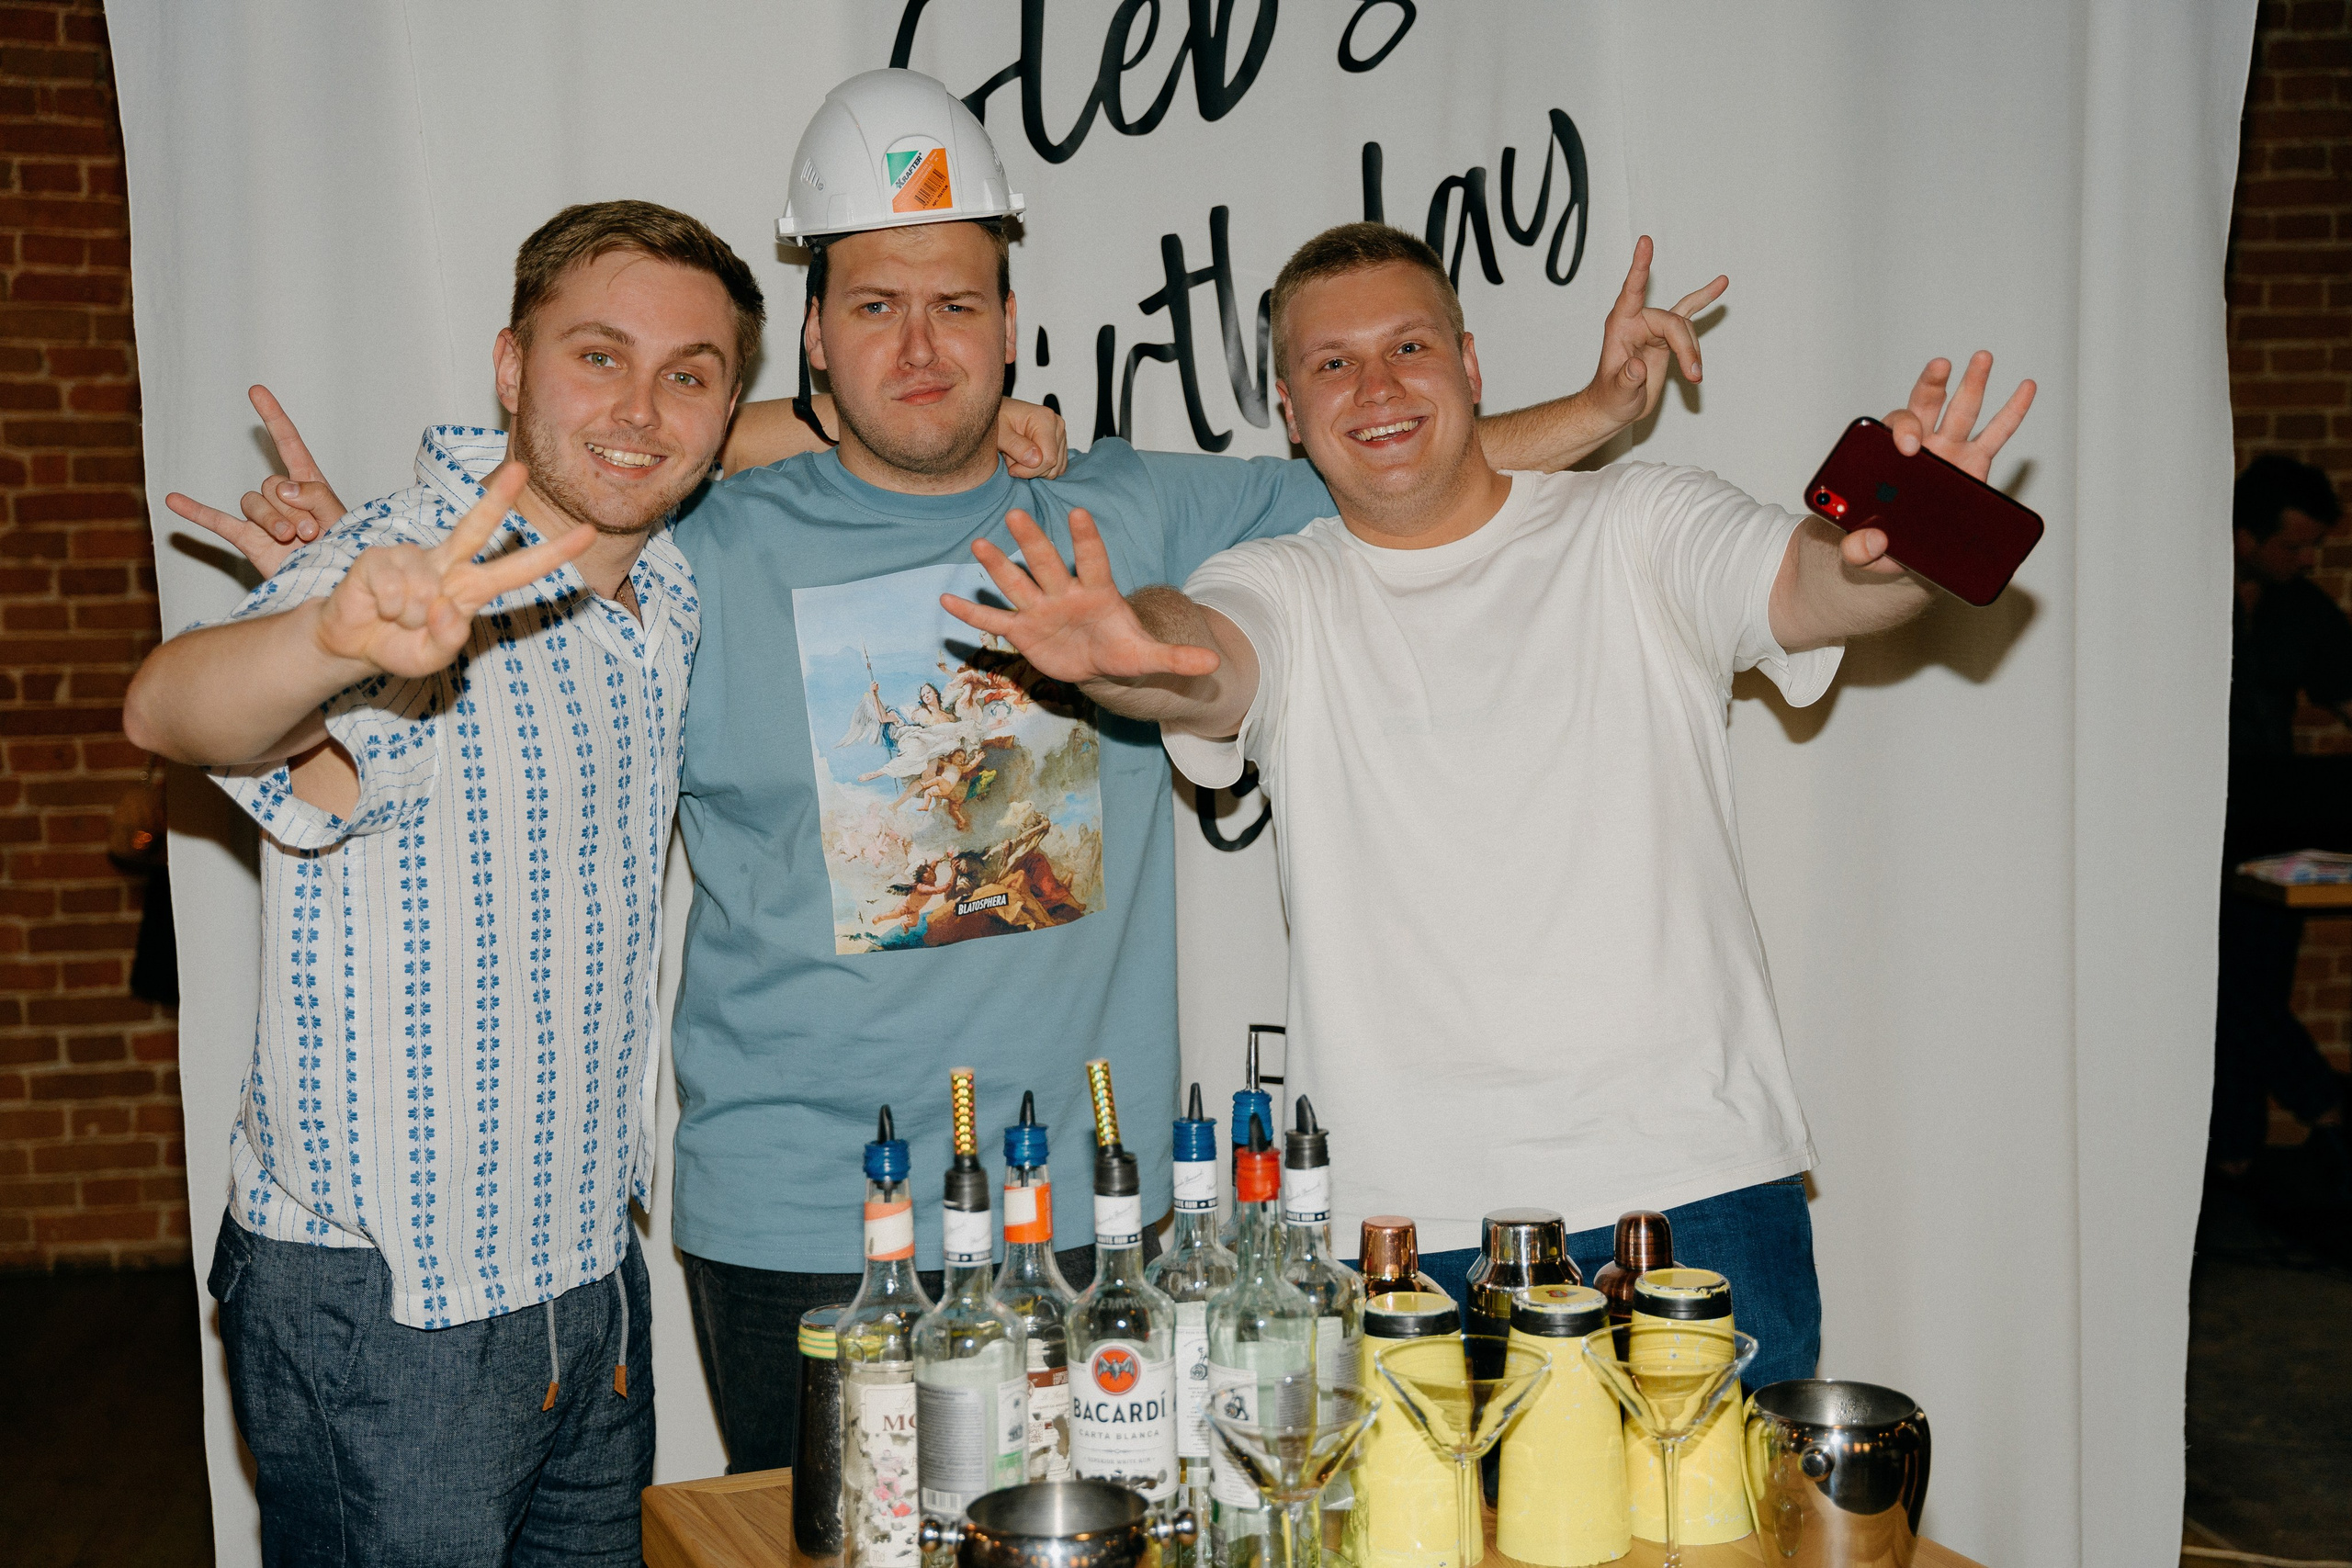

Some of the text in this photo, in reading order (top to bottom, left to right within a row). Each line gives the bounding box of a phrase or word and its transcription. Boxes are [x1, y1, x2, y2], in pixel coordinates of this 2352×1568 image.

[895, 153, 922, 189] KRAFTER
[957, 894, 1007, 915] BLATOSPHERA
[1073, 1390, 1166, 1424] BACARDÍ
[1079, 1428, 1159, 1440] CARTA BLANCA
